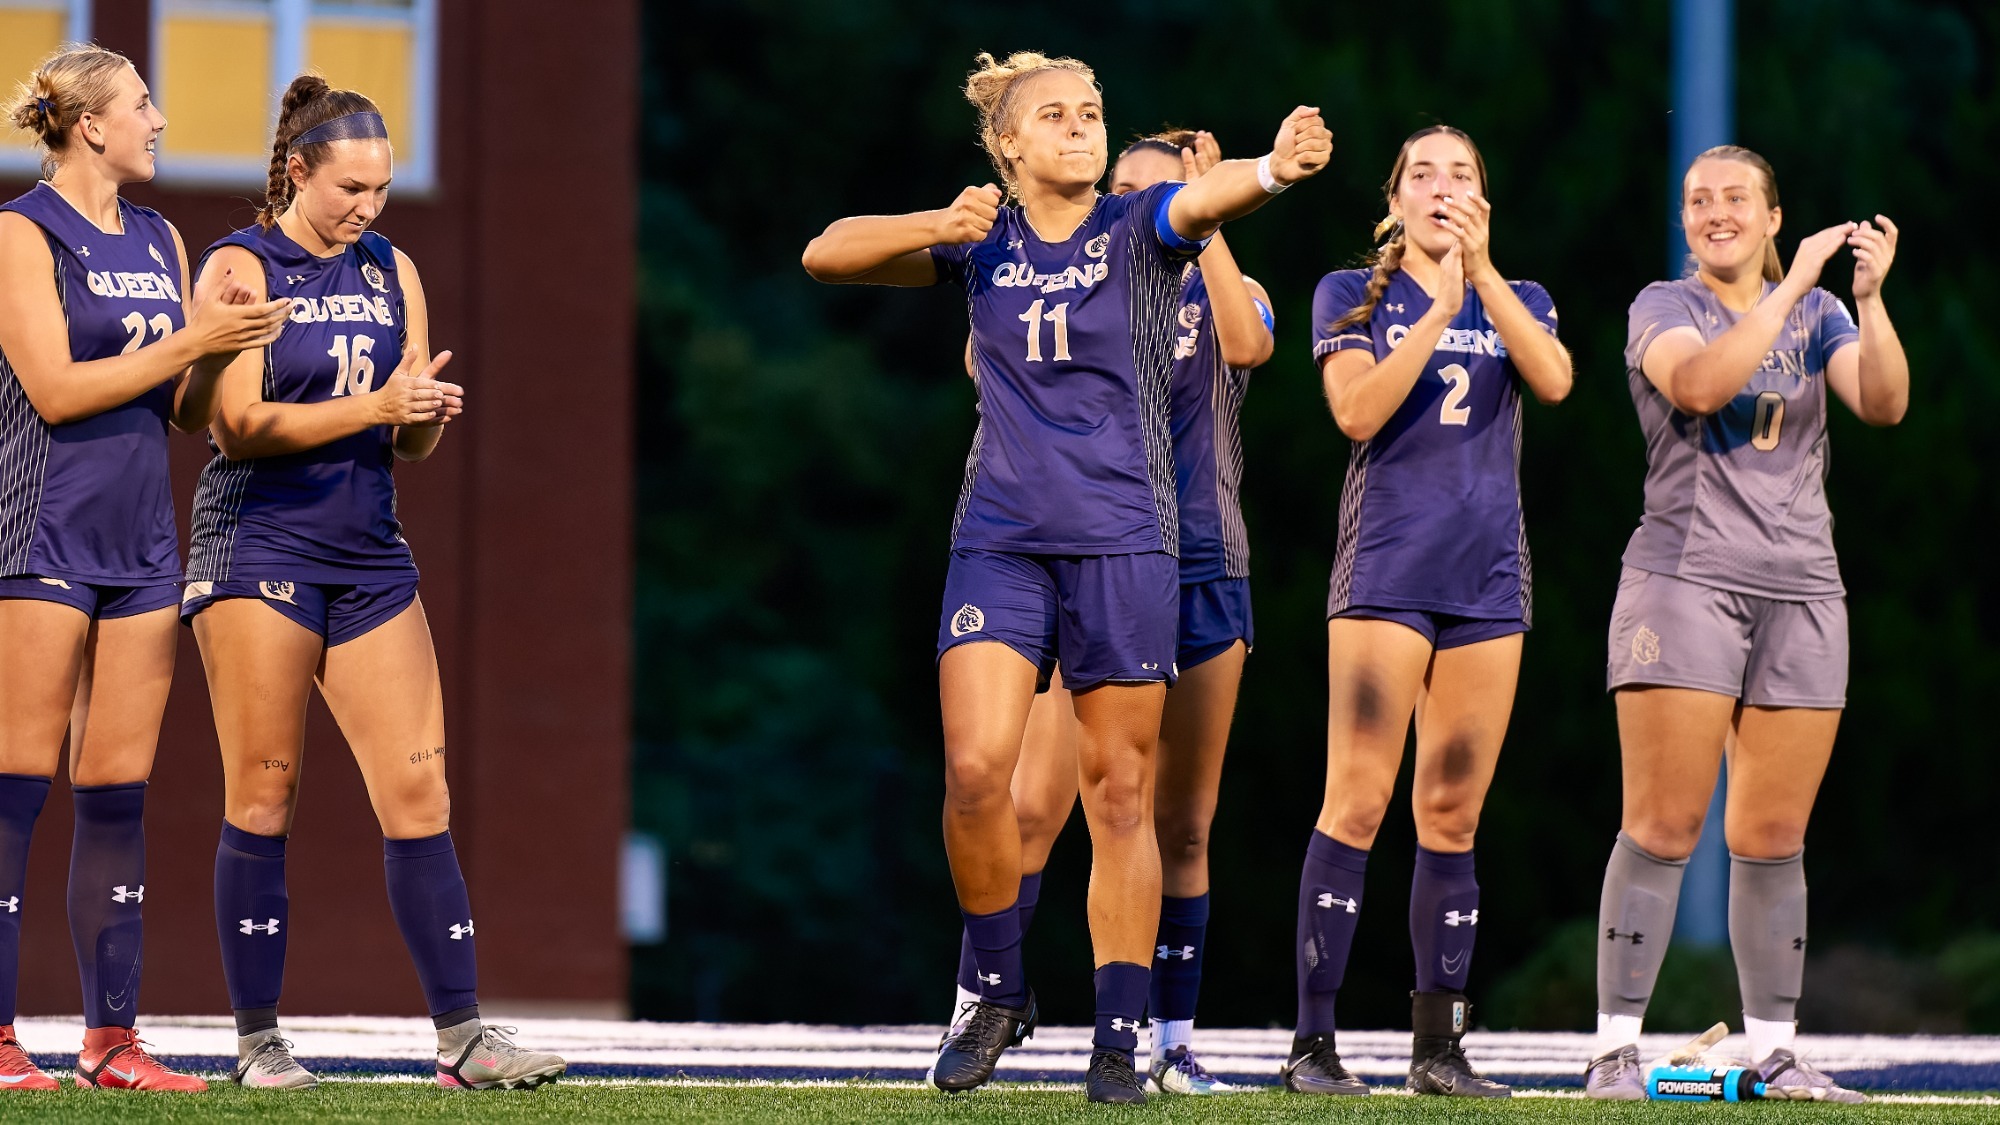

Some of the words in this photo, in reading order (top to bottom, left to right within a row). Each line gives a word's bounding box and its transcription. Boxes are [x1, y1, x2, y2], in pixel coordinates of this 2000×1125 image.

[87, 270, 181, 303] QUEEN
[1018, 299, 1072, 362] 11
[1386, 324, 1508, 357] QEENS
[327, 334, 376, 397] 16
[1437, 363, 1471, 426] 2
[1751, 391, 1786, 451] 0
[1657, 1081, 1723, 1095] POWERADE
